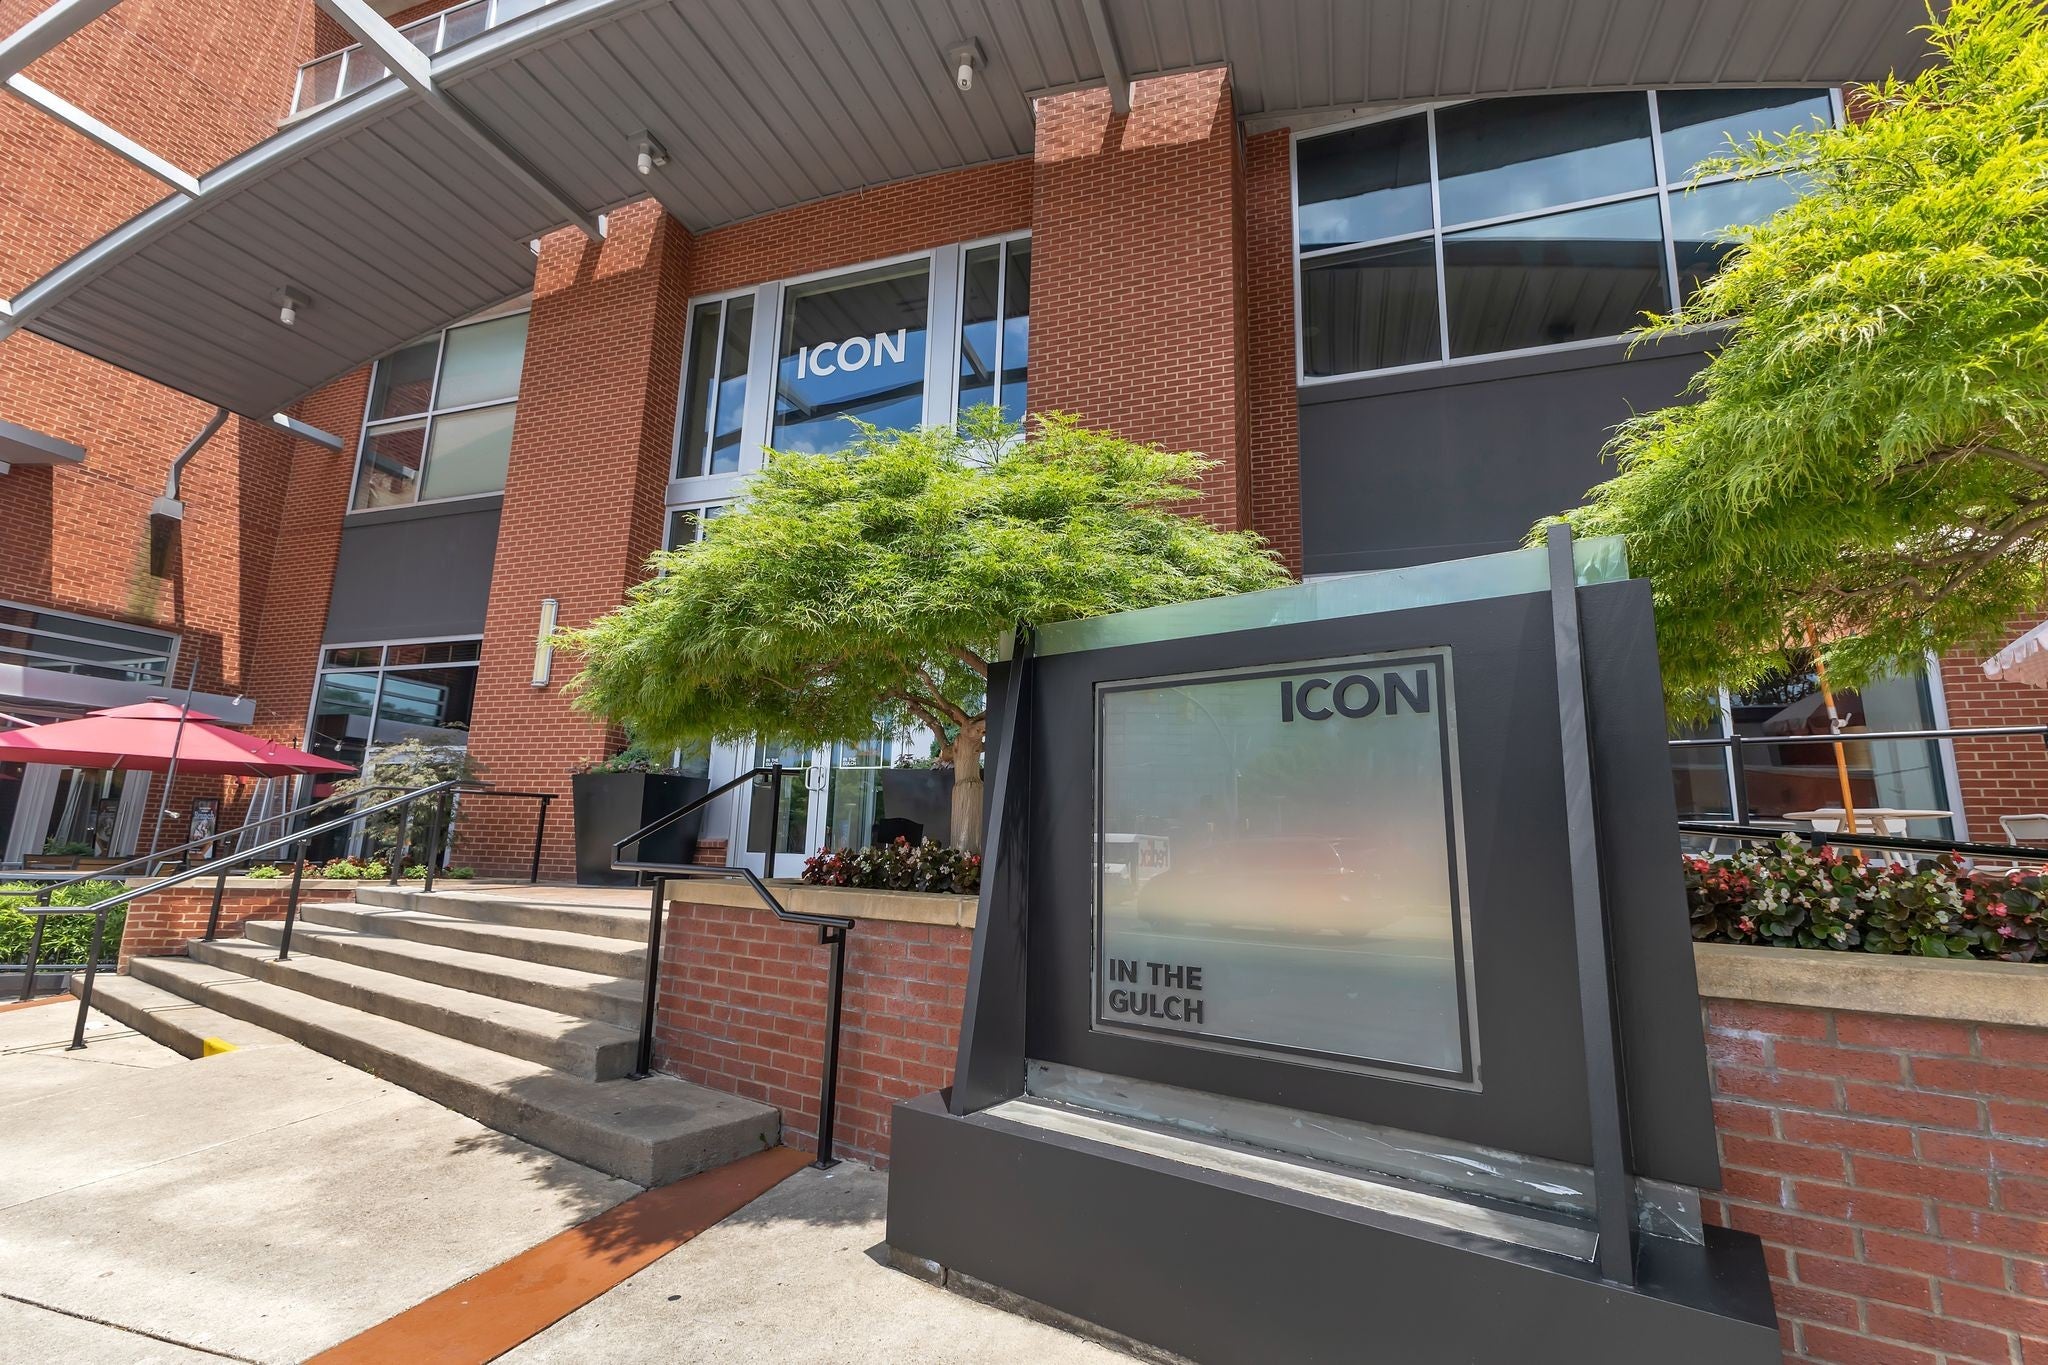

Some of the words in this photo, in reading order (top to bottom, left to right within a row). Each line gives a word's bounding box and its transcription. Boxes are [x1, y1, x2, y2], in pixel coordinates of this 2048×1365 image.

[797, 328, 907, 379] ICON
[1280, 669, 1430, 722] ICON
[1109, 958, 1138, 983] IN
[1146, 962, 1203, 991] THE
[1109, 989, 1204, 1024] GULCH
